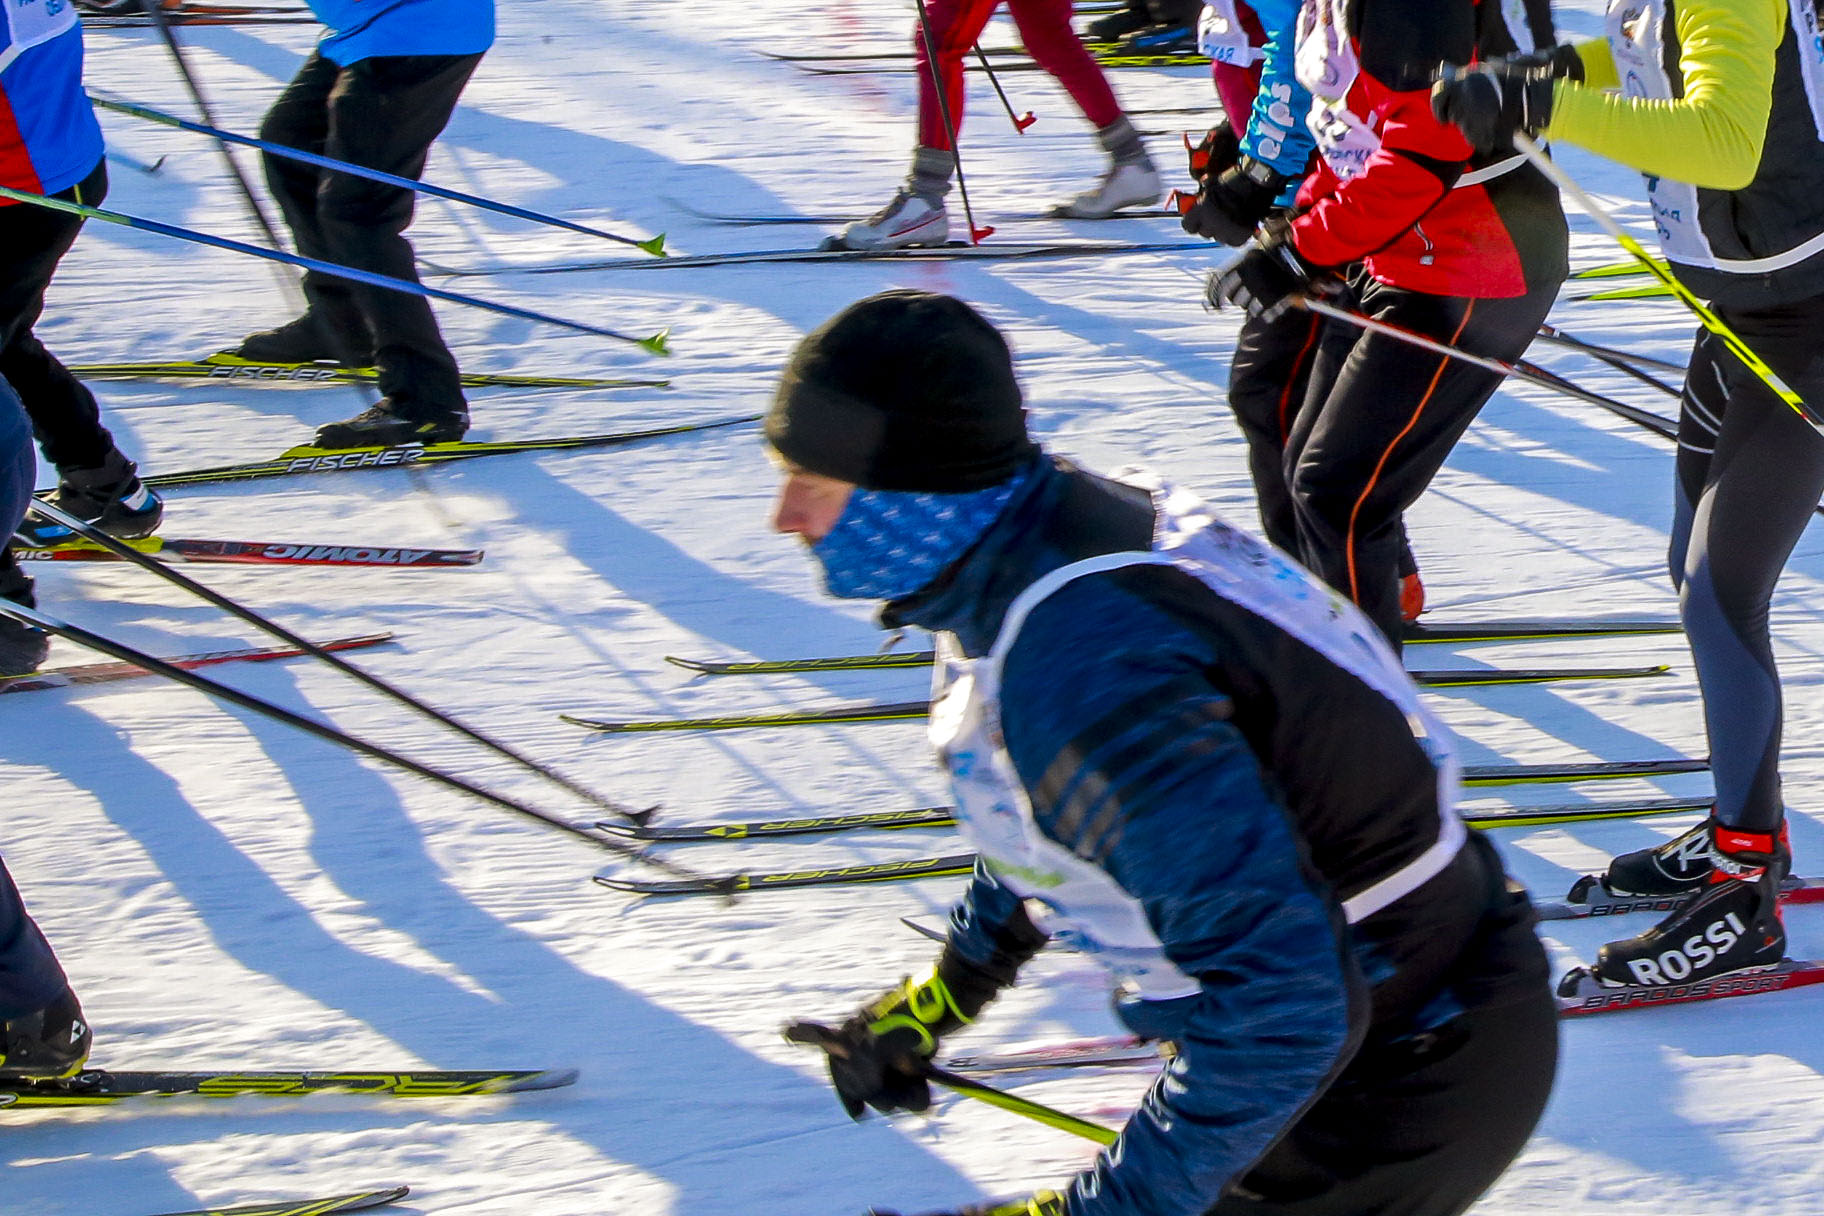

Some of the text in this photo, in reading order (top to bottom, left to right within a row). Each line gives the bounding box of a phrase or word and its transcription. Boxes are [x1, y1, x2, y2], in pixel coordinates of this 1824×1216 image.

[208, 366, 337, 381] FISCHER
[287, 448, 426, 472] FISCHER
[262, 544, 431, 565] ATOMIC
[759, 807, 938, 830] FISCHER
[761, 858, 940, 882] FISCHER
[1627, 912, 1747, 984] ROSSI
[1713, 975, 1790, 995] SPORT
